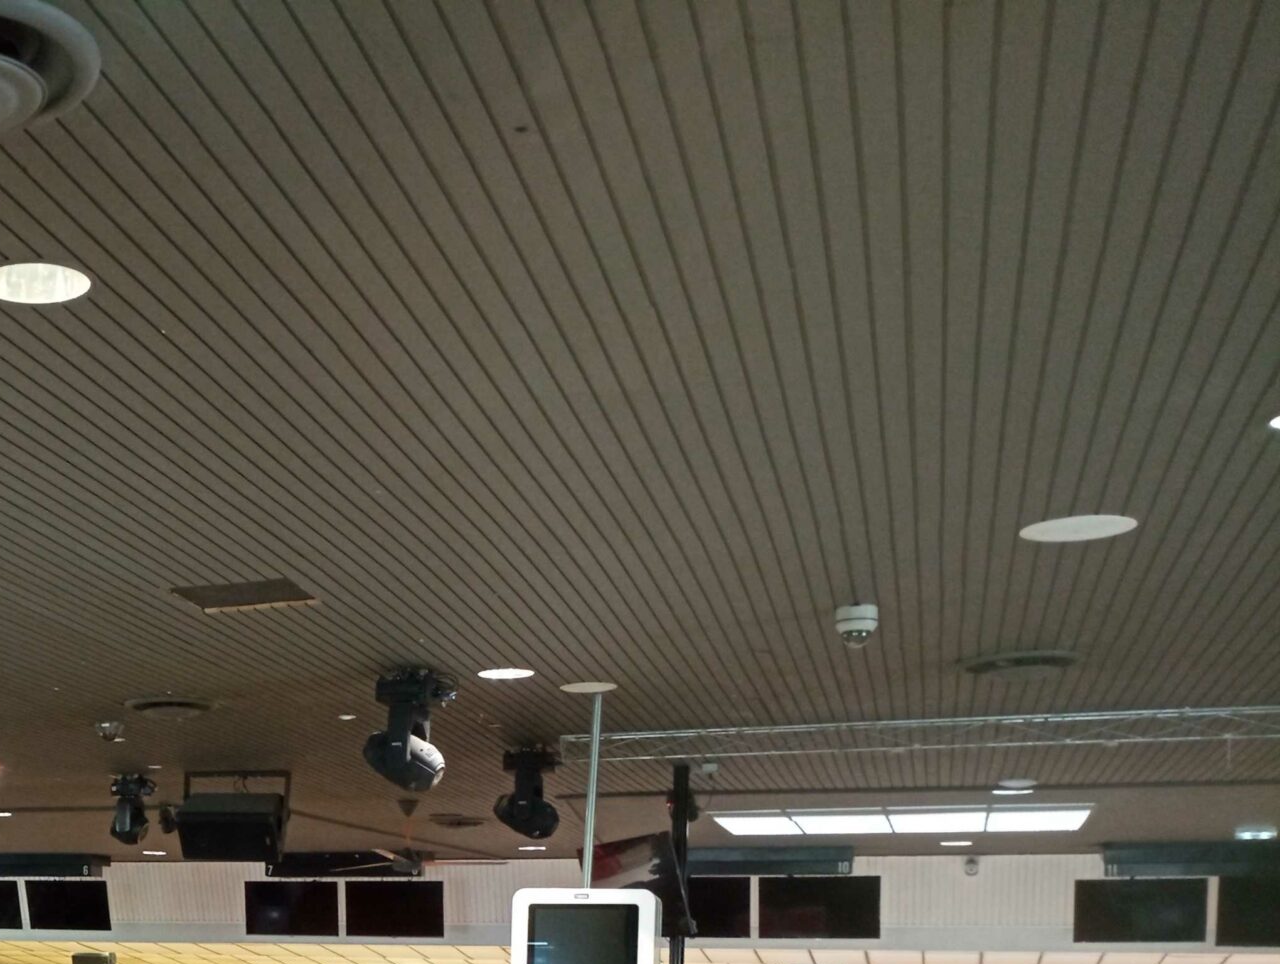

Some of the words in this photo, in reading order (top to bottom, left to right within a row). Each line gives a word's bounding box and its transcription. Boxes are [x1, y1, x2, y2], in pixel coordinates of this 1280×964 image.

[82, 865, 89, 876] 6
[267, 865, 273, 876] 7
[838, 861, 849, 874] 10
